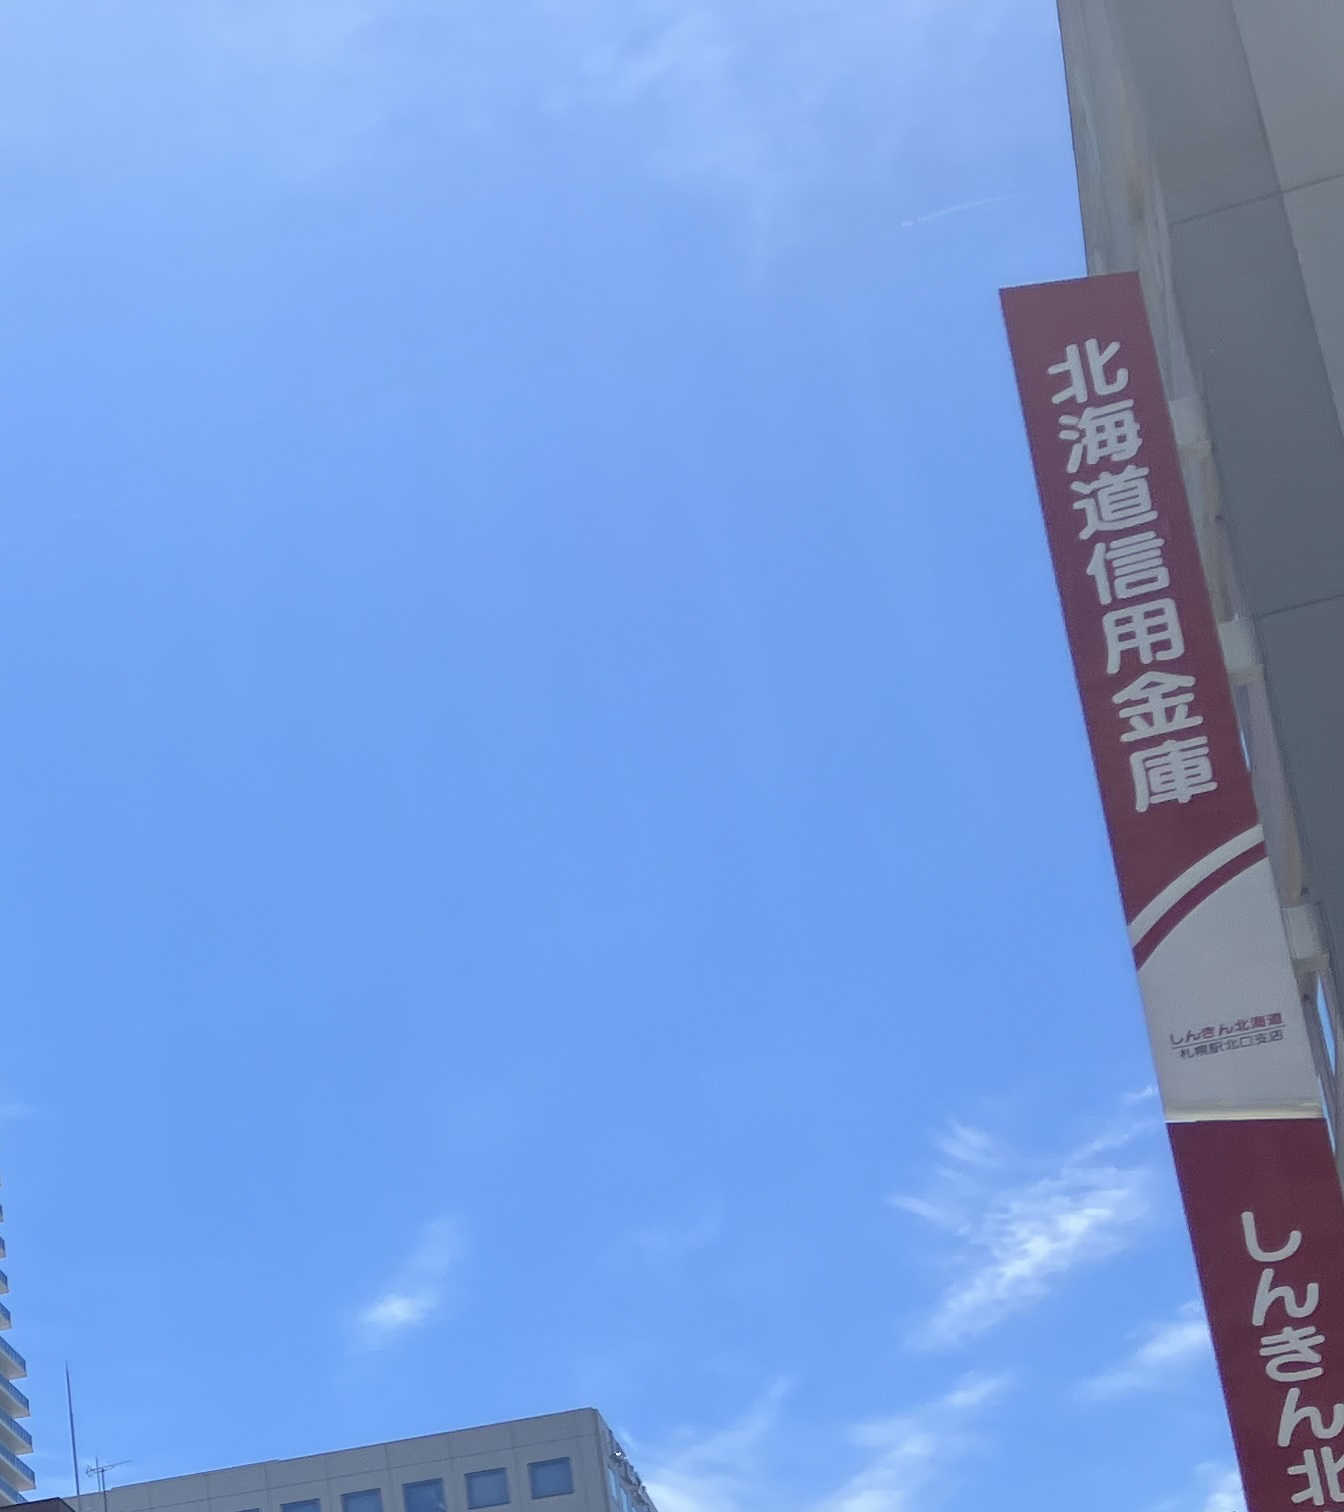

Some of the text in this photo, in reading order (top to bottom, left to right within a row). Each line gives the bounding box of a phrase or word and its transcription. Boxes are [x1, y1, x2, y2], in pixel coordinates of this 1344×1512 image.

[1046, 337, 1218, 814] 北海道信用金庫
